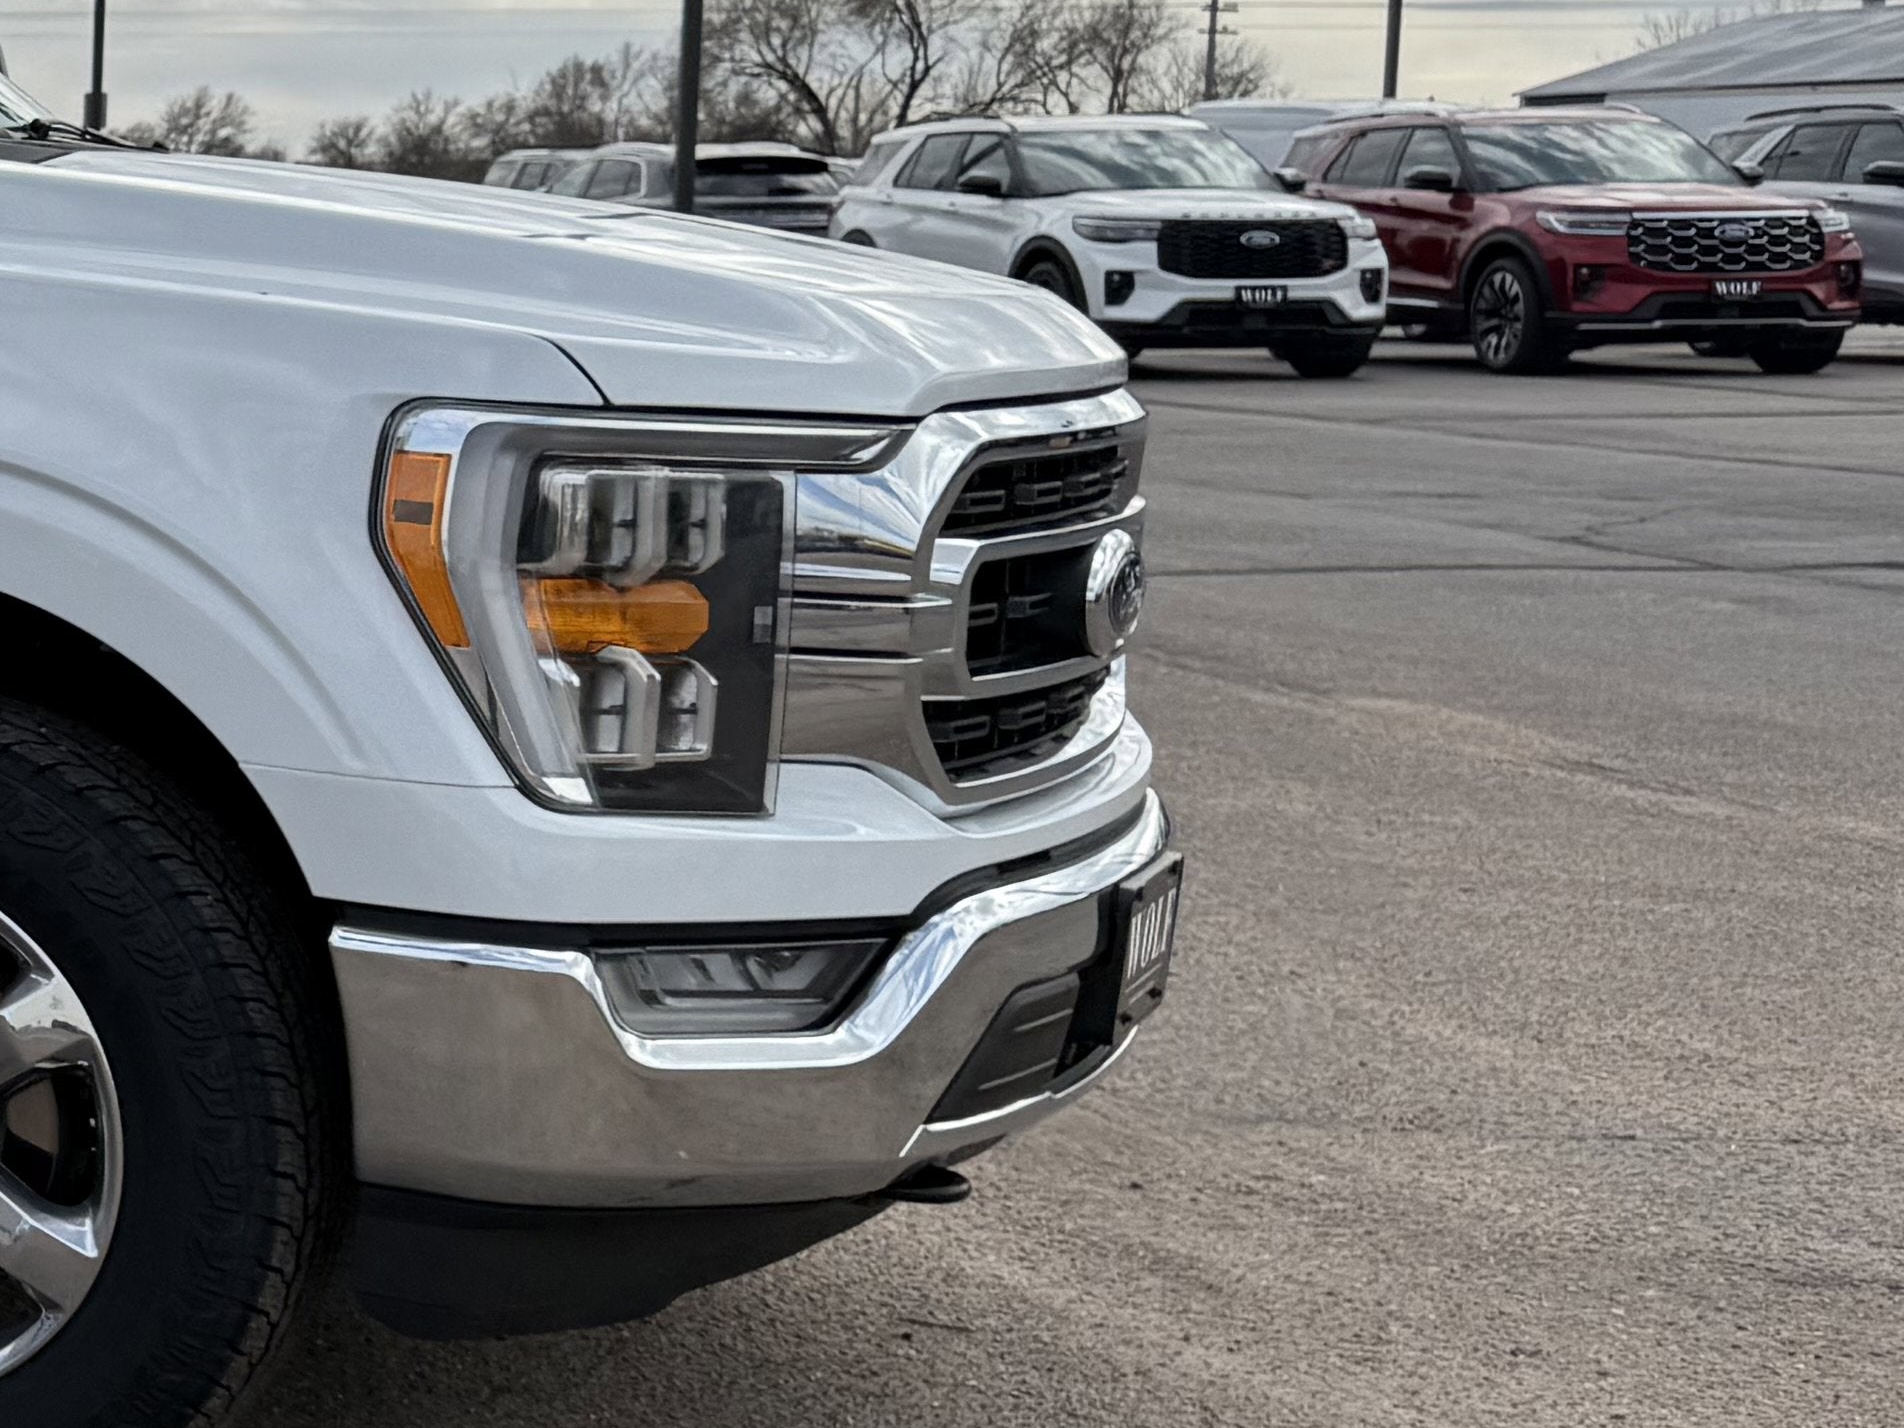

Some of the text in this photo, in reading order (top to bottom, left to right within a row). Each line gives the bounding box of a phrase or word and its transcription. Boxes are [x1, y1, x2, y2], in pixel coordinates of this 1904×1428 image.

[1240, 288, 1284, 303] WOLF
[1715, 281, 1762, 296] WOLF
[1127, 887, 1177, 980] WOLF
